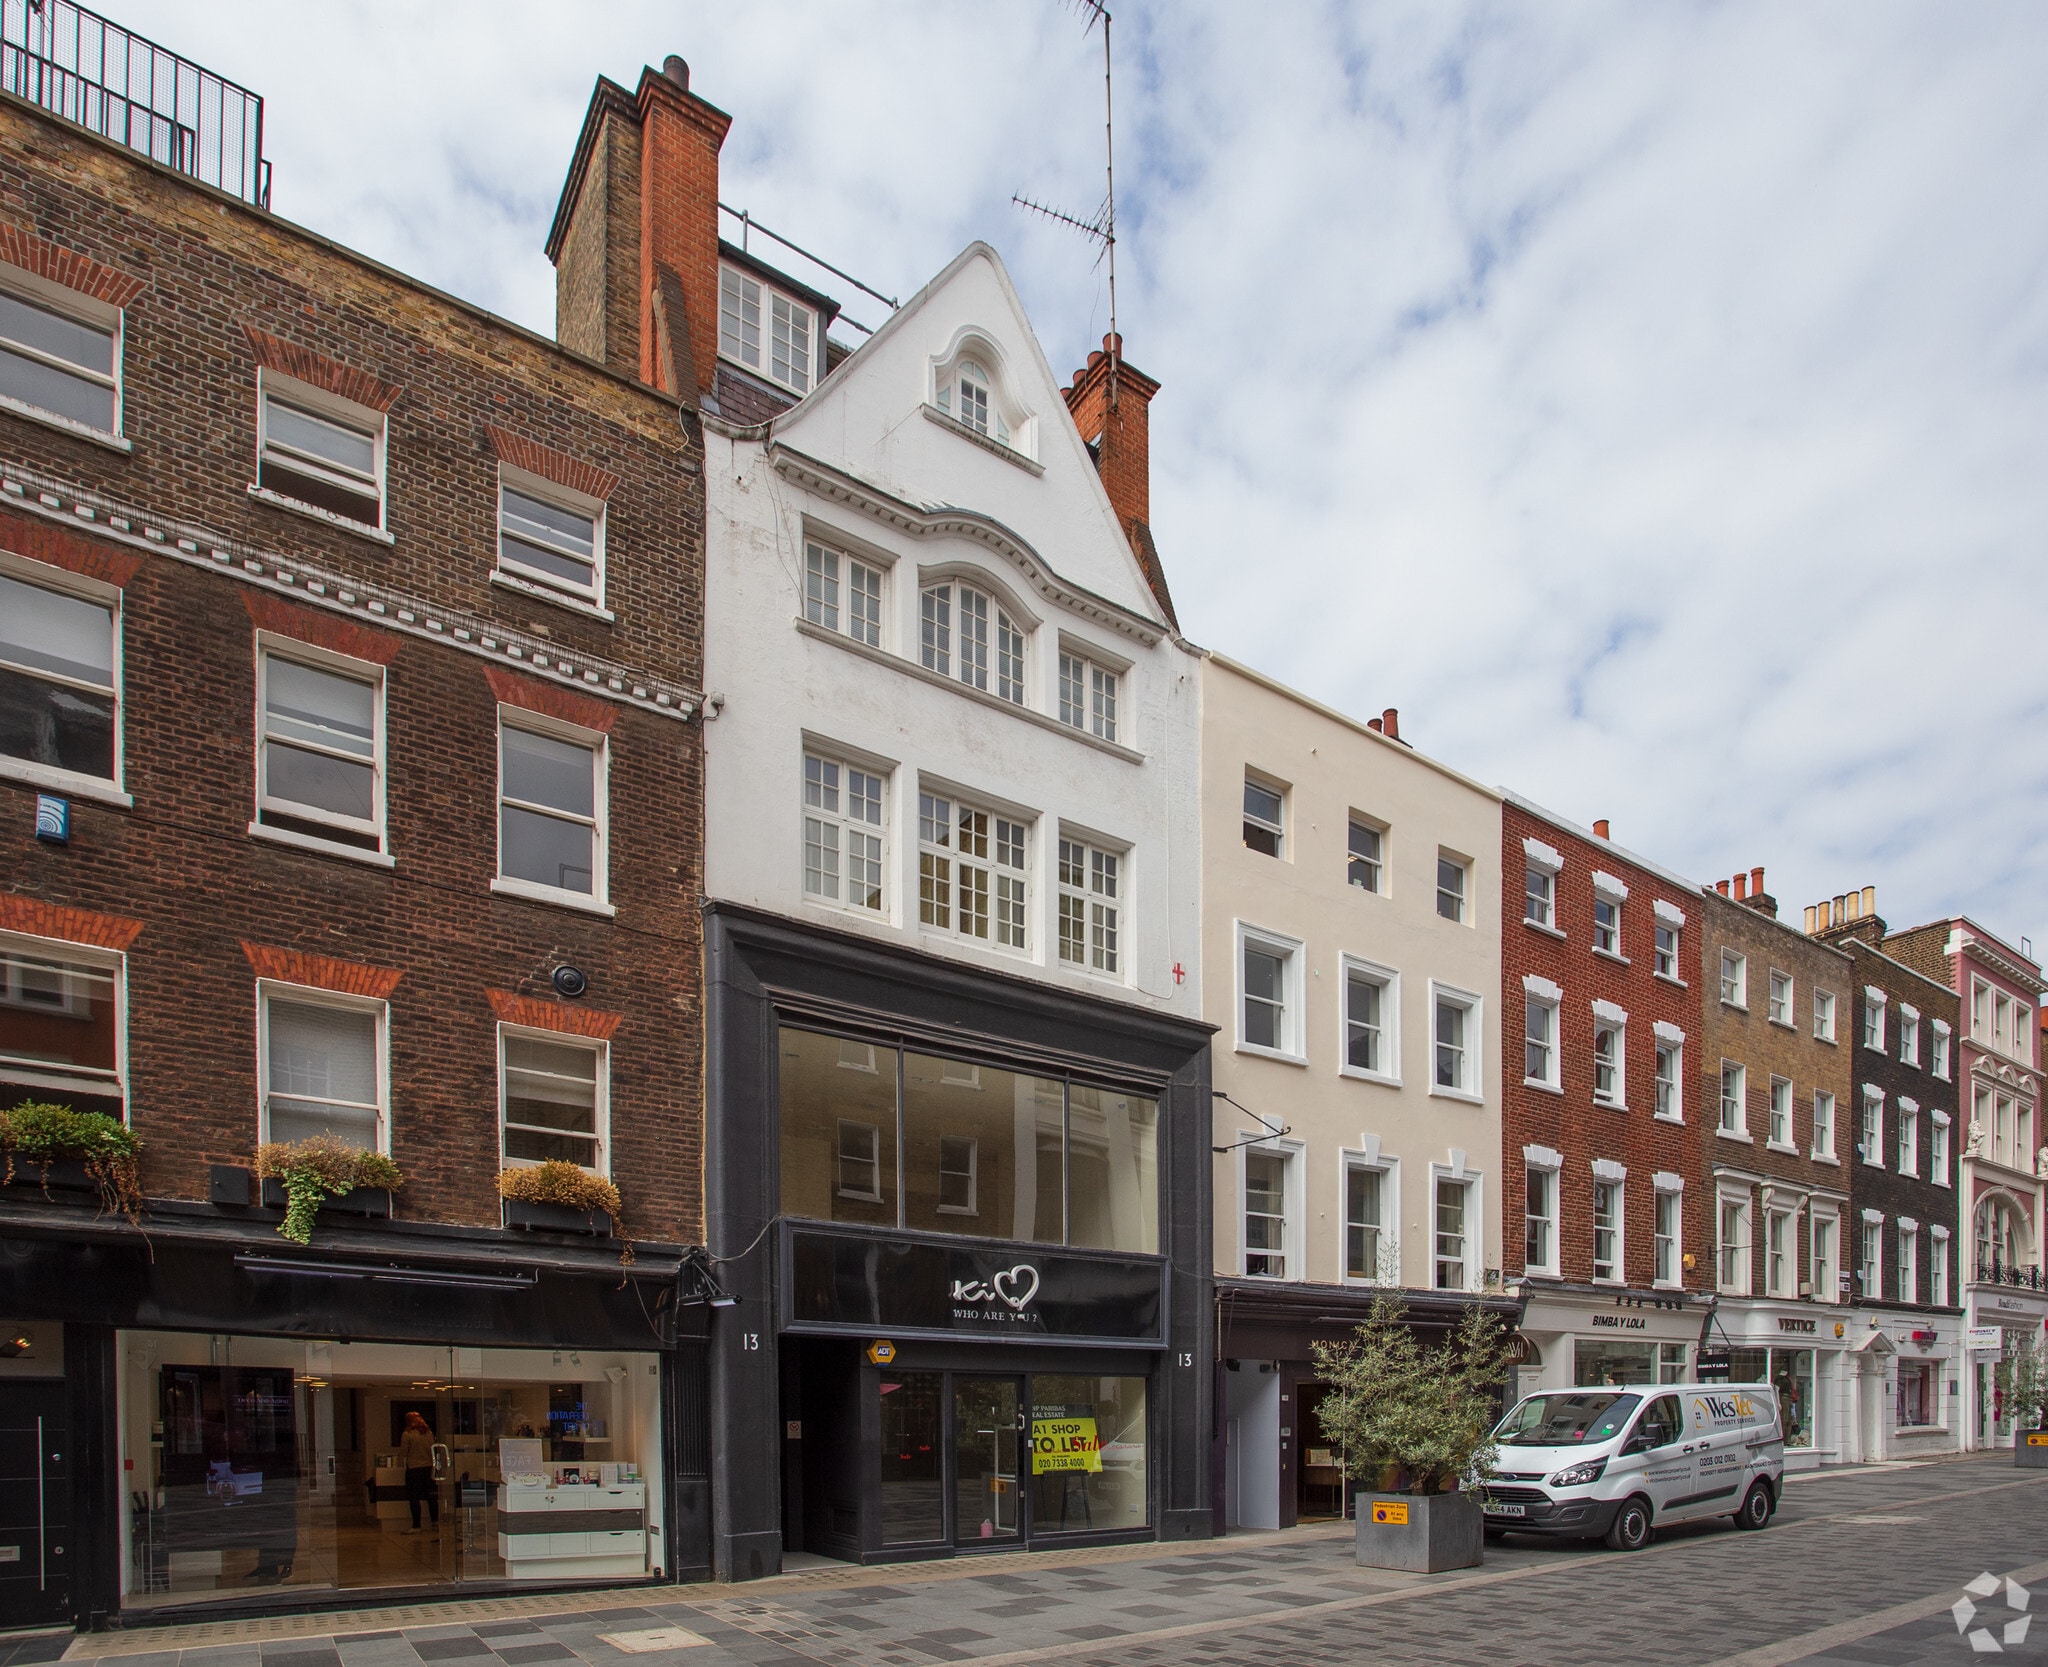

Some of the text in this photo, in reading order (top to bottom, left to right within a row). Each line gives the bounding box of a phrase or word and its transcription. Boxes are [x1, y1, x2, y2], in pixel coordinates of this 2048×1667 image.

[953, 1309, 978, 1319] WHO
[983, 1311, 1005, 1320] ARE
[1592, 1316, 1645, 1329] BIMBA Y LOLA
[743, 1333, 759, 1350] 13
[878, 1347, 890, 1355] ADT
[1179, 1353, 1192, 1367] 13
[1704, 1394, 1755, 1418] WesTec
[1033, 1424, 1081, 1435] A1 SHOP
[1032, 1437, 1055, 1454] TO
[1038, 1458, 1085, 1468] 020 7338 4000
[1700, 1454, 1736, 1467] 0203 012 0102
[1507, 1506, 1522, 1514] AKN
